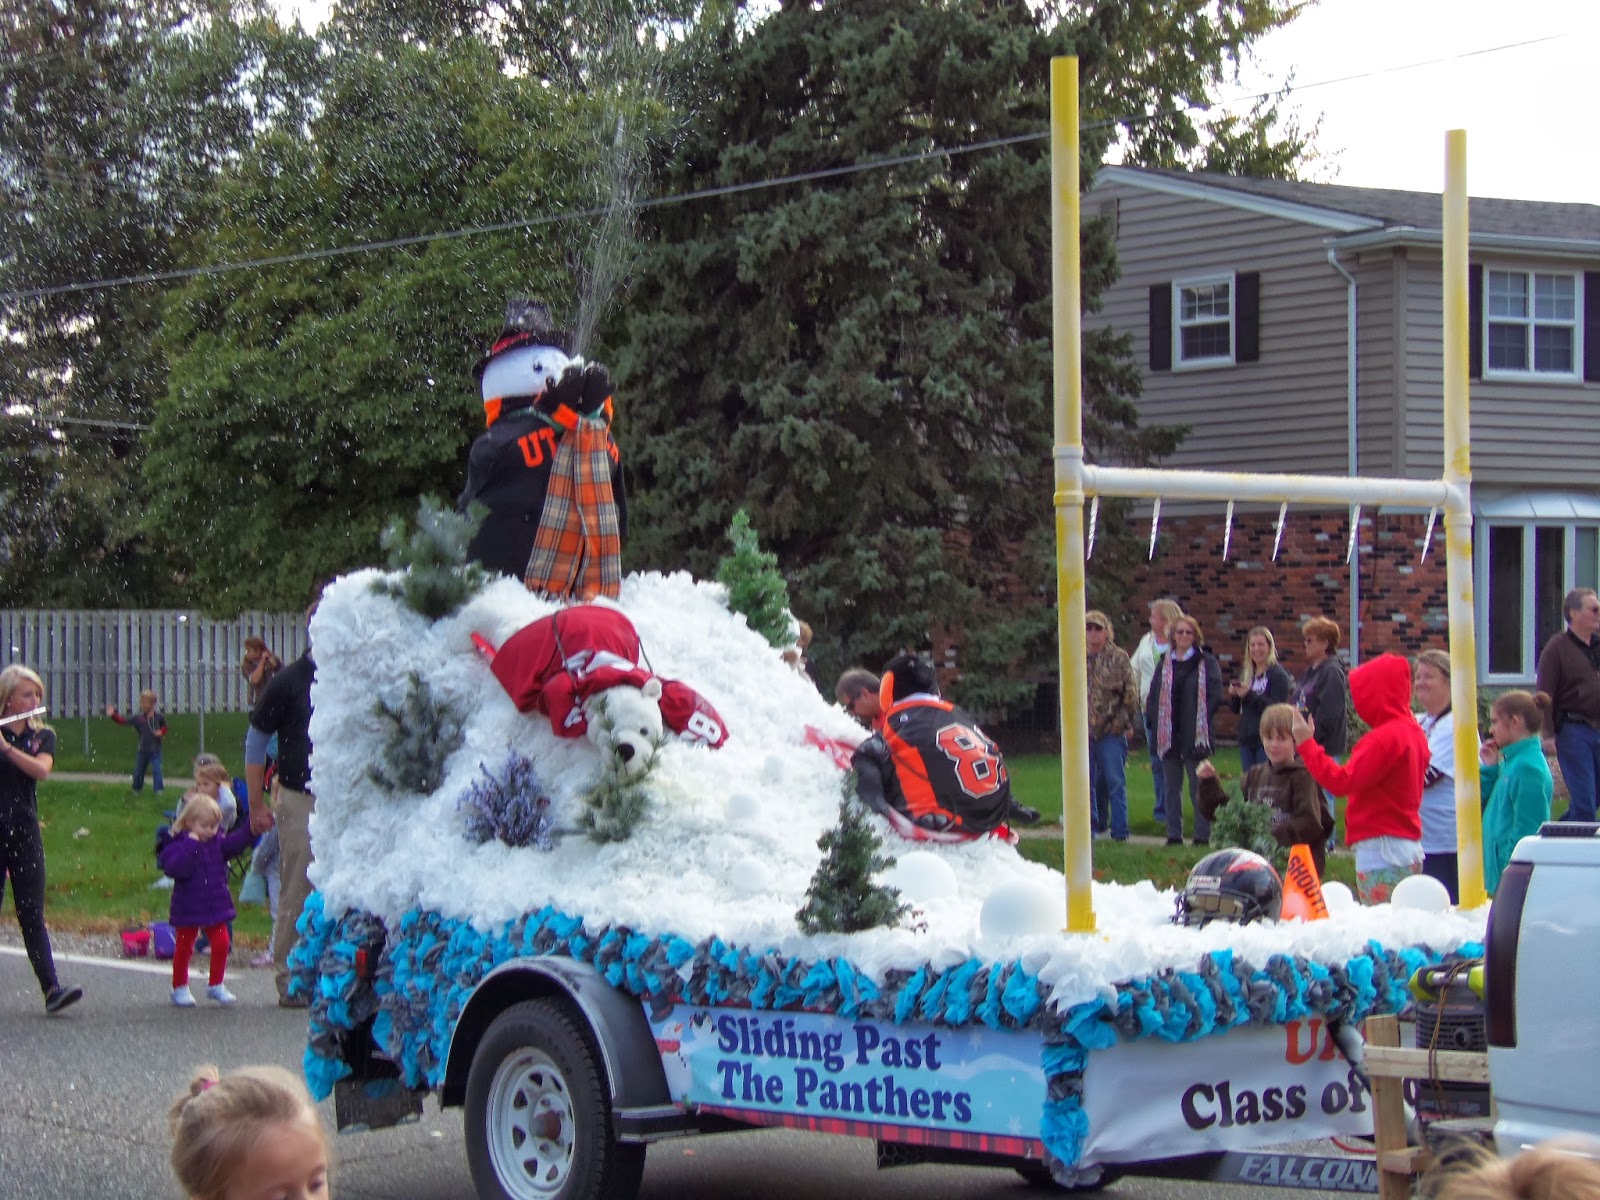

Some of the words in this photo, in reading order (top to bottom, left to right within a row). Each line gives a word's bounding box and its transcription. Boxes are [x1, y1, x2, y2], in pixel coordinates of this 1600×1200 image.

[717, 1013, 845, 1073] Sliding
[852, 1024, 942, 1071] Past
[716, 1060, 784, 1104] The
[794, 1066, 972, 1123] Panthers
[1181, 1079, 1307, 1131] Class
[1320, 1067, 1367, 1115] of
[1238, 1155, 1379, 1192] FALCON
